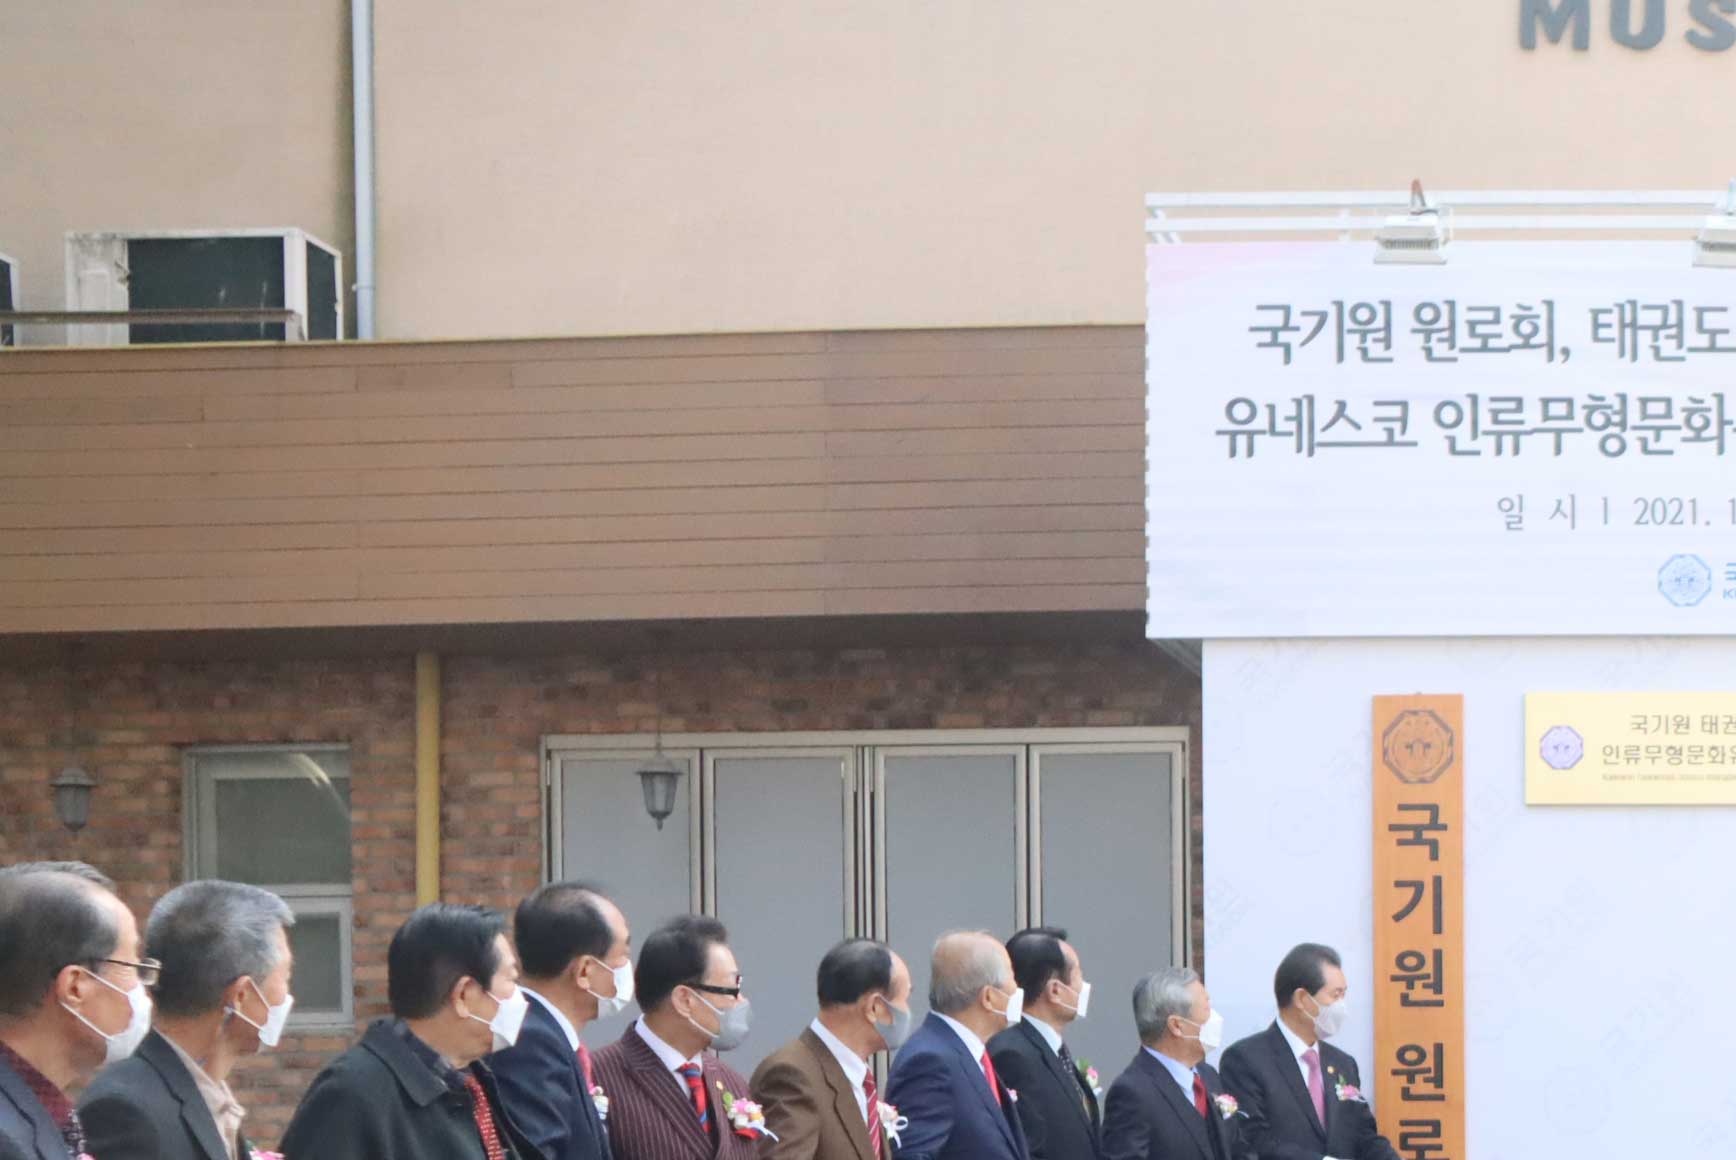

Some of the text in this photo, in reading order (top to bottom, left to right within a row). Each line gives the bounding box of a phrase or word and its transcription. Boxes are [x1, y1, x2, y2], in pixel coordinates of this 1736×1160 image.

[1248, 300, 1394, 365] 국기원
[1410, 300, 1571, 363] 원로회,
[1215, 394, 1418, 458] 유네스코
[1497, 494, 1523, 531] 일
[1549, 494, 1575, 530] 시
[1634, 497, 1711, 527] 2021.
[1631, 714, 1691, 736] 국기원
[1388, 803, 1448, 1007] 국기원
